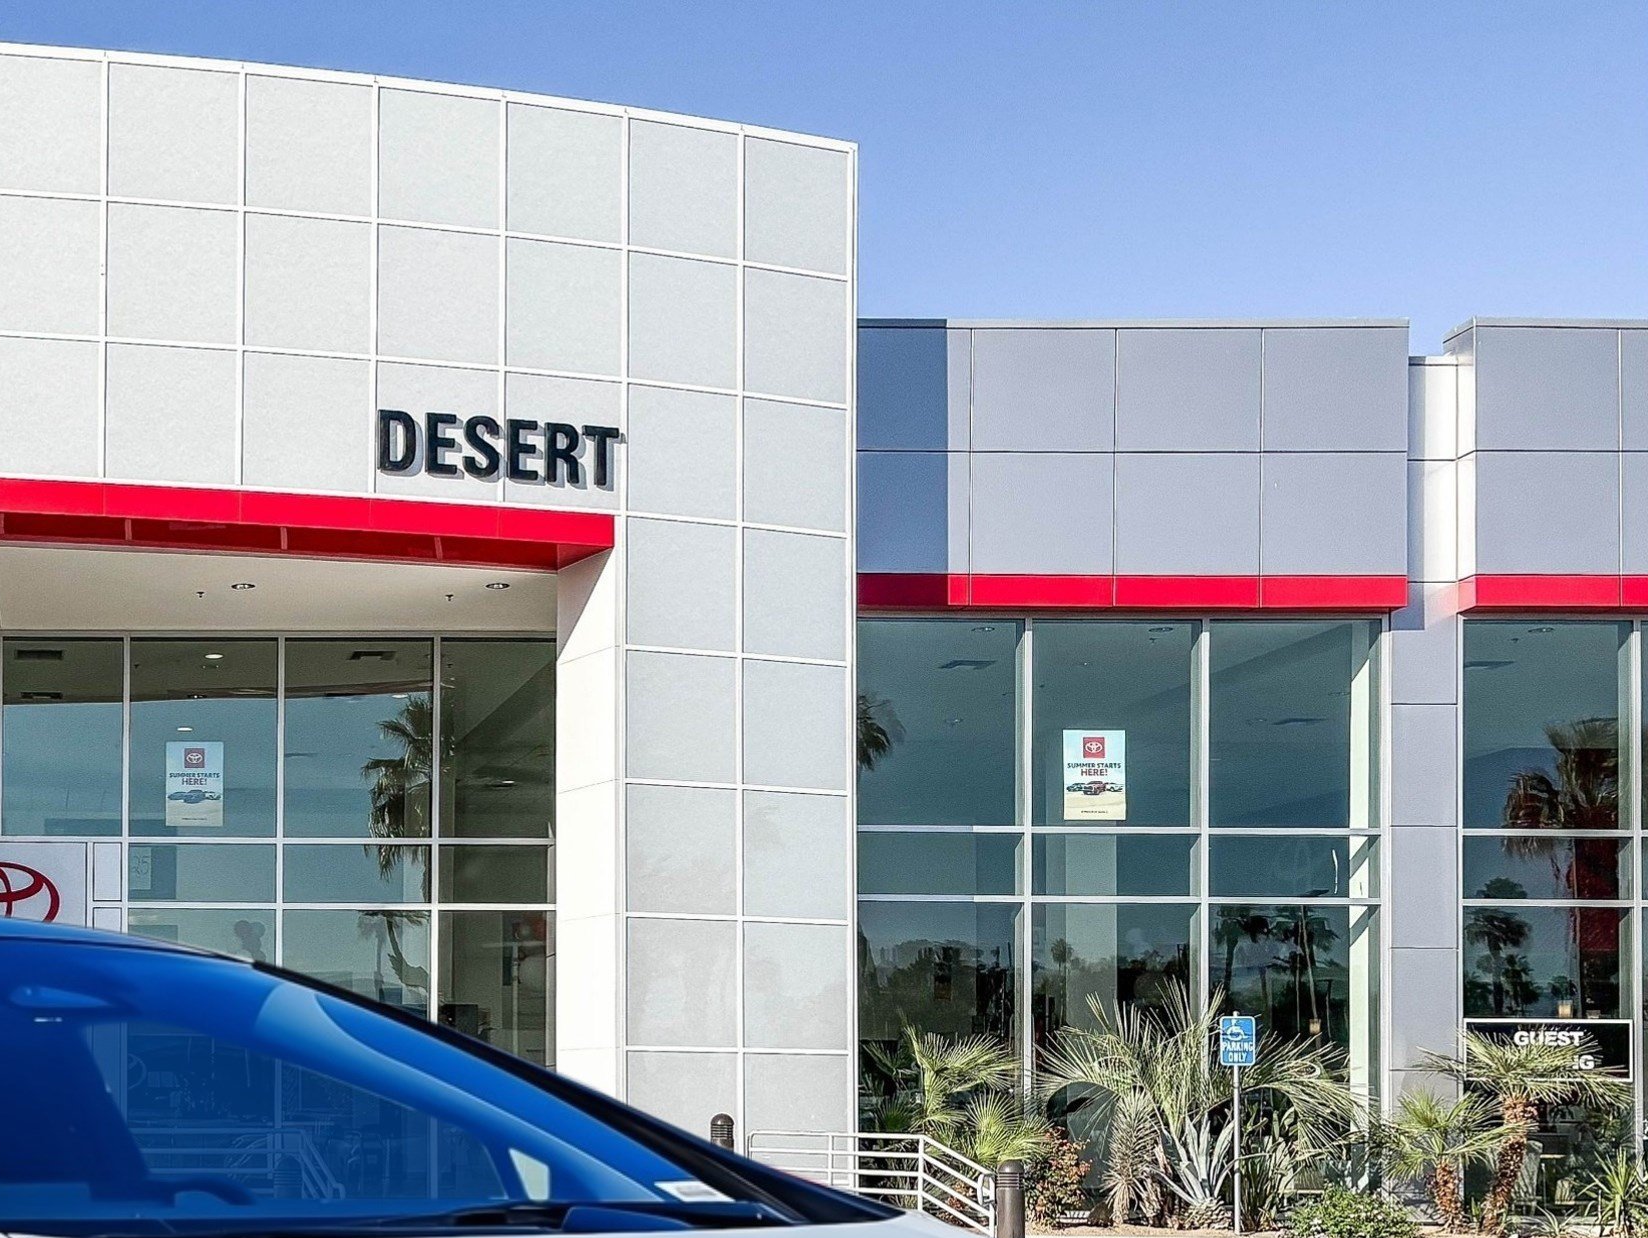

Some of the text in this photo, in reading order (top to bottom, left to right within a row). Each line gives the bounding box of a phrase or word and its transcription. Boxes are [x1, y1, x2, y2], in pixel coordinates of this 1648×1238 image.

[377, 409, 620, 486] DESERT
[182, 778, 207, 786] HERE!
[1513, 1030, 1585, 1047] GUEST
[1222, 1041, 1254, 1051] PARKING
[1228, 1052, 1247, 1062] ONLY
